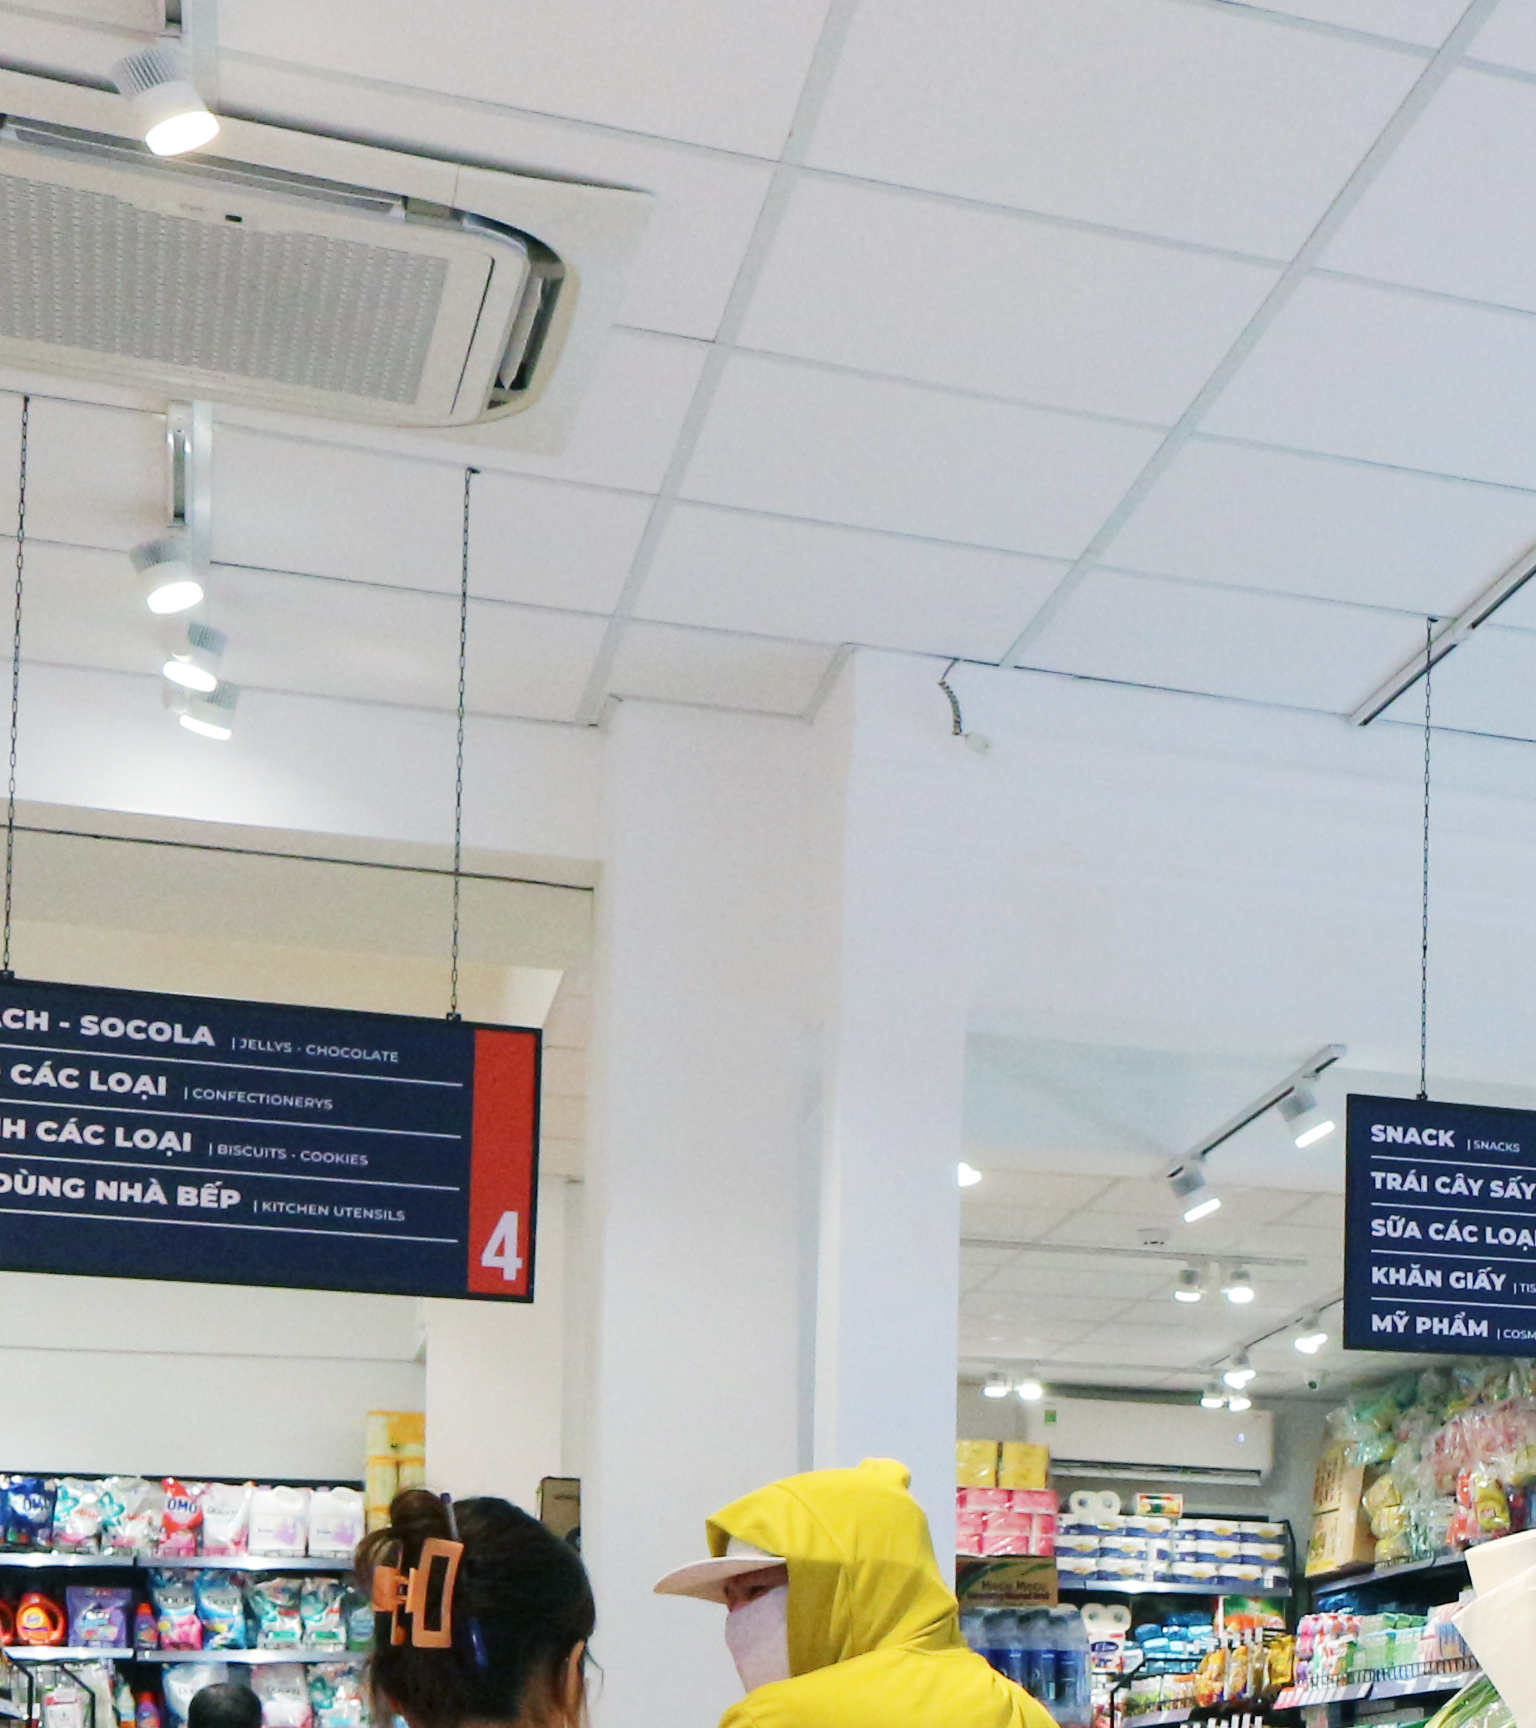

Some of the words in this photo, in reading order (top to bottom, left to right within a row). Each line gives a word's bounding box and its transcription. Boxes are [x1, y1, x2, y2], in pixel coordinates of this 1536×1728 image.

[0, 1007, 49, 1032] CH
[79, 1015, 216, 1046] SOCOLA
[240, 1038, 291, 1053] JELLYS
[306, 1044, 399, 1063] CHOCOLATE
[10, 1060, 80, 1091] CÁC
[89, 1069, 168, 1100] LOẠI
[192, 1087, 333, 1111] CONFECTIONERYS
[35, 1117, 105, 1146] CÁC
[115, 1125, 193, 1157] LOẠI
[217, 1143, 287, 1161] BISCUITS
[300, 1149, 369, 1167] COOKIES
[1370, 1123, 1455, 1149] SNACK
[1473, 1140, 1520, 1154] SNACKS
[95, 1172, 168, 1206] NHÀ
[176, 1180, 242, 1211] BẾP
[262, 1200, 329, 1218] KITCHEN
[334, 1204, 406, 1222] UTENSILS
[1370, 1170, 1428, 1194] TRÁI
[1435, 1172, 1484, 1198] CÂY
[1489, 1176, 1536, 1201] SẤY
[1370, 1215, 1422, 1240] SỮA
[1428, 1219, 1480, 1244] CÁC
[480, 1210, 524, 1282] 4
[1371, 1265, 1442, 1290] KHĂN
[1449, 1267, 1506, 1292] GIẤY
[1371, 1309, 1409, 1333] MỸ
[1416, 1311, 1488, 1338] PHẨM
[167, 1498, 198, 1513] OMO
